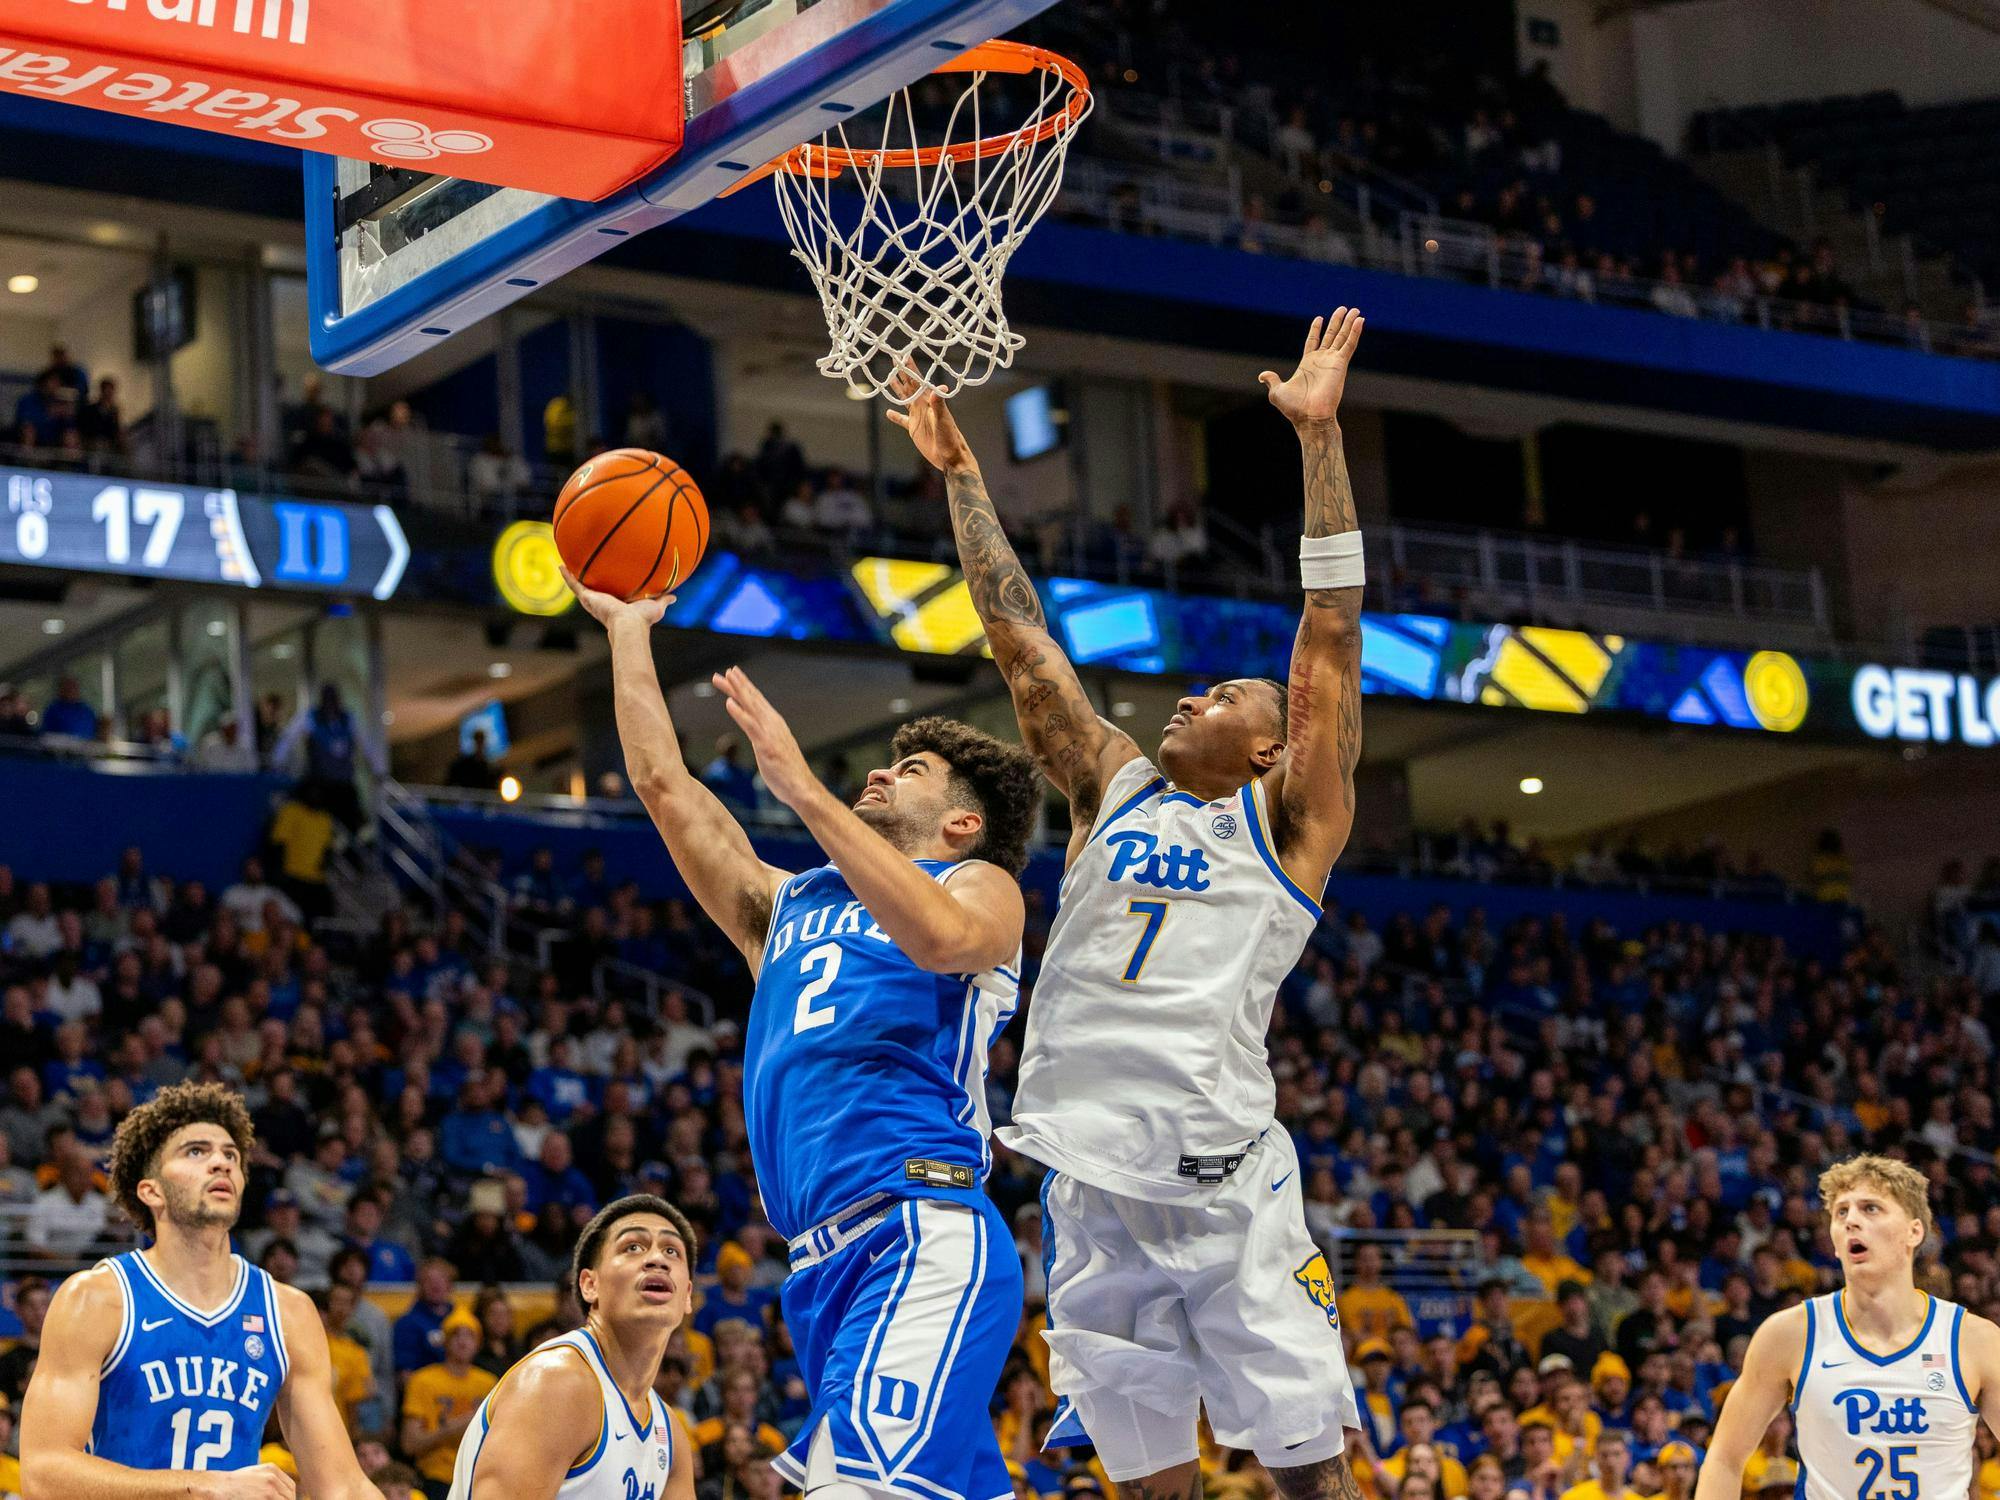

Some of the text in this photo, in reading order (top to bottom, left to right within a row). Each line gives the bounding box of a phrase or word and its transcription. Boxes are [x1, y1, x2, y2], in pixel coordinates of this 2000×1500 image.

[16, 510, 49, 560] 0
[92, 485, 185, 568] 17
[272, 501, 350, 585] D
[1853, 664, 1955, 743] GET
[1106, 831, 1211, 892] Pitt
[1121, 899, 1170, 984] 7
[793, 942, 843, 1036] 2
[953, 1170, 966, 1180] 48
[1227, 1160, 1238, 1170] 46
[140, 1356, 269, 1412] DUKE
[872, 1374, 920, 1421] D
[1833, 1388, 1930, 1435] Pitt
[170, 1407, 235, 1471] 12
[1855, 1446, 1920, 1500] 25
